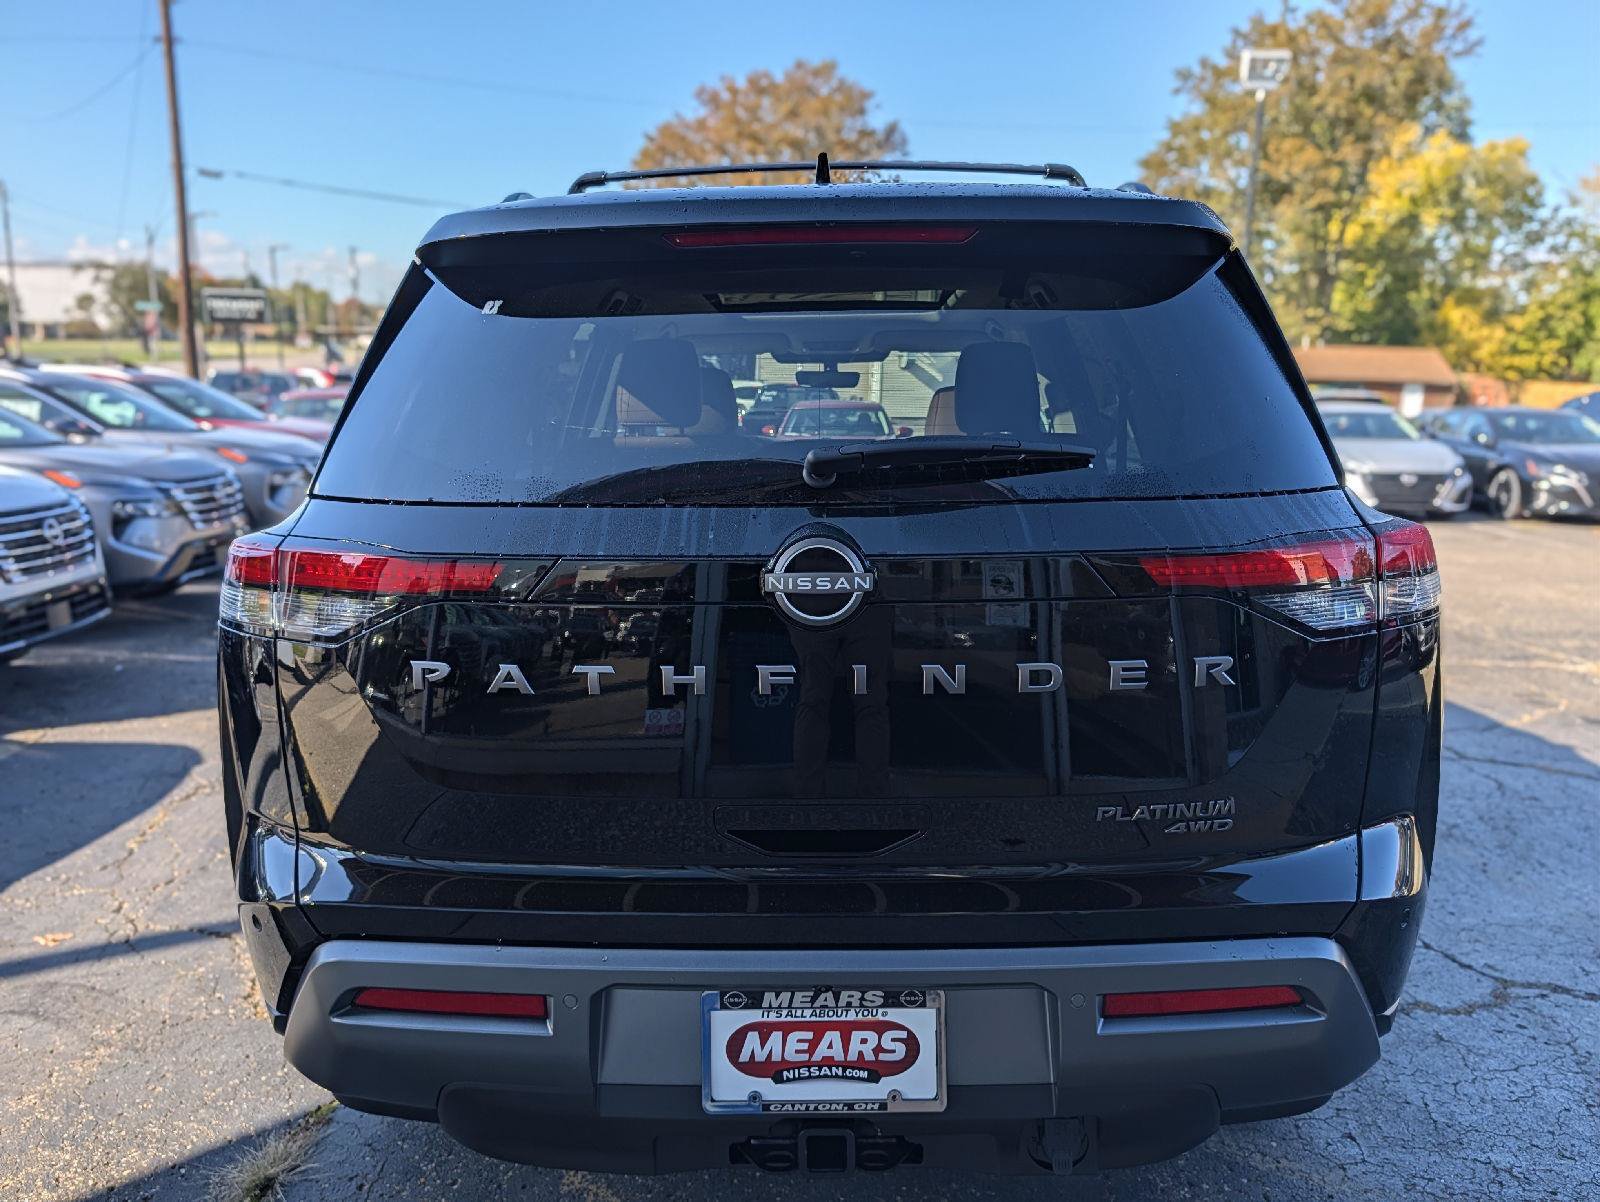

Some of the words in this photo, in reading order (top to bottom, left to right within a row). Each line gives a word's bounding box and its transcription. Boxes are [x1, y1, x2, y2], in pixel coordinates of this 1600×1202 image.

[768, 576, 870, 590] NISSAN
[410, 655, 1236, 694] PATHFINDER
[1096, 796, 1236, 821] PLATINUM
[1164, 819, 1233, 833] 4WD
[761, 990, 885, 1008] MEARS
[761, 1008, 783, 1019] IT'S
[785, 1008, 807, 1019] ALL
[809, 1008, 851, 1019] ABOUT
[854, 1008, 879, 1018] YOU
[738, 1030, 908, 1063] MEARS
[769, 1103, 848, 1112] CANTON,
